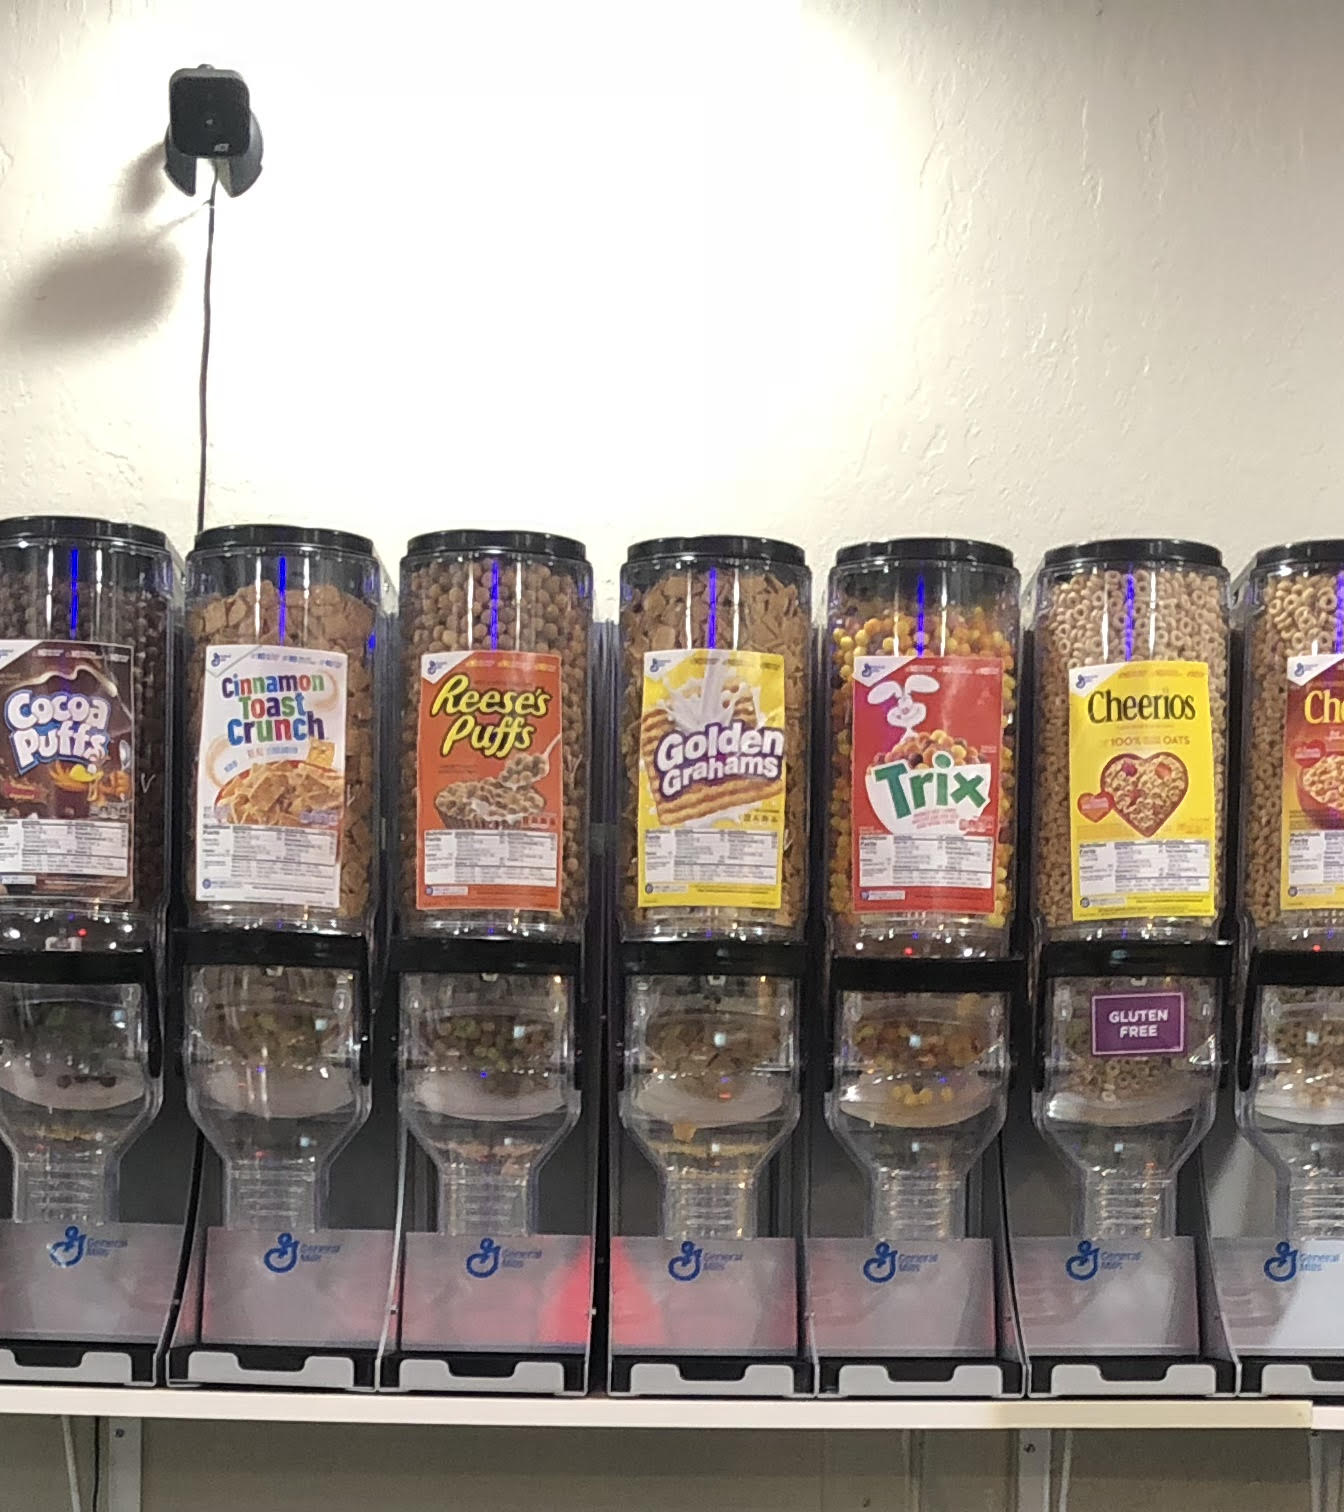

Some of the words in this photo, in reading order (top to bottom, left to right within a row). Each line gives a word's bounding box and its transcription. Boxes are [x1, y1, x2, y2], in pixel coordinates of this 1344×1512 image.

[221, 672, 324, 699] Cinnamon
[431, 675, 551, 717] Reese's
[7, 692, 109, 729] Cocoa
[238, 693, 307, 719] Toast
[1087, 689, 1196, 723] Cheerios
[12, 727, 108, 768] Puffs
[442, 714, 536, 758] Puffs
[658, 728, 784, 771] Golden
[662, 755, 779, 796] Grahams
[875, 751, 986, 819] Trix
[1109, 1009, 1169, 1025] GLUTEN
[1119, 1023, 1159, 1039] FREE
